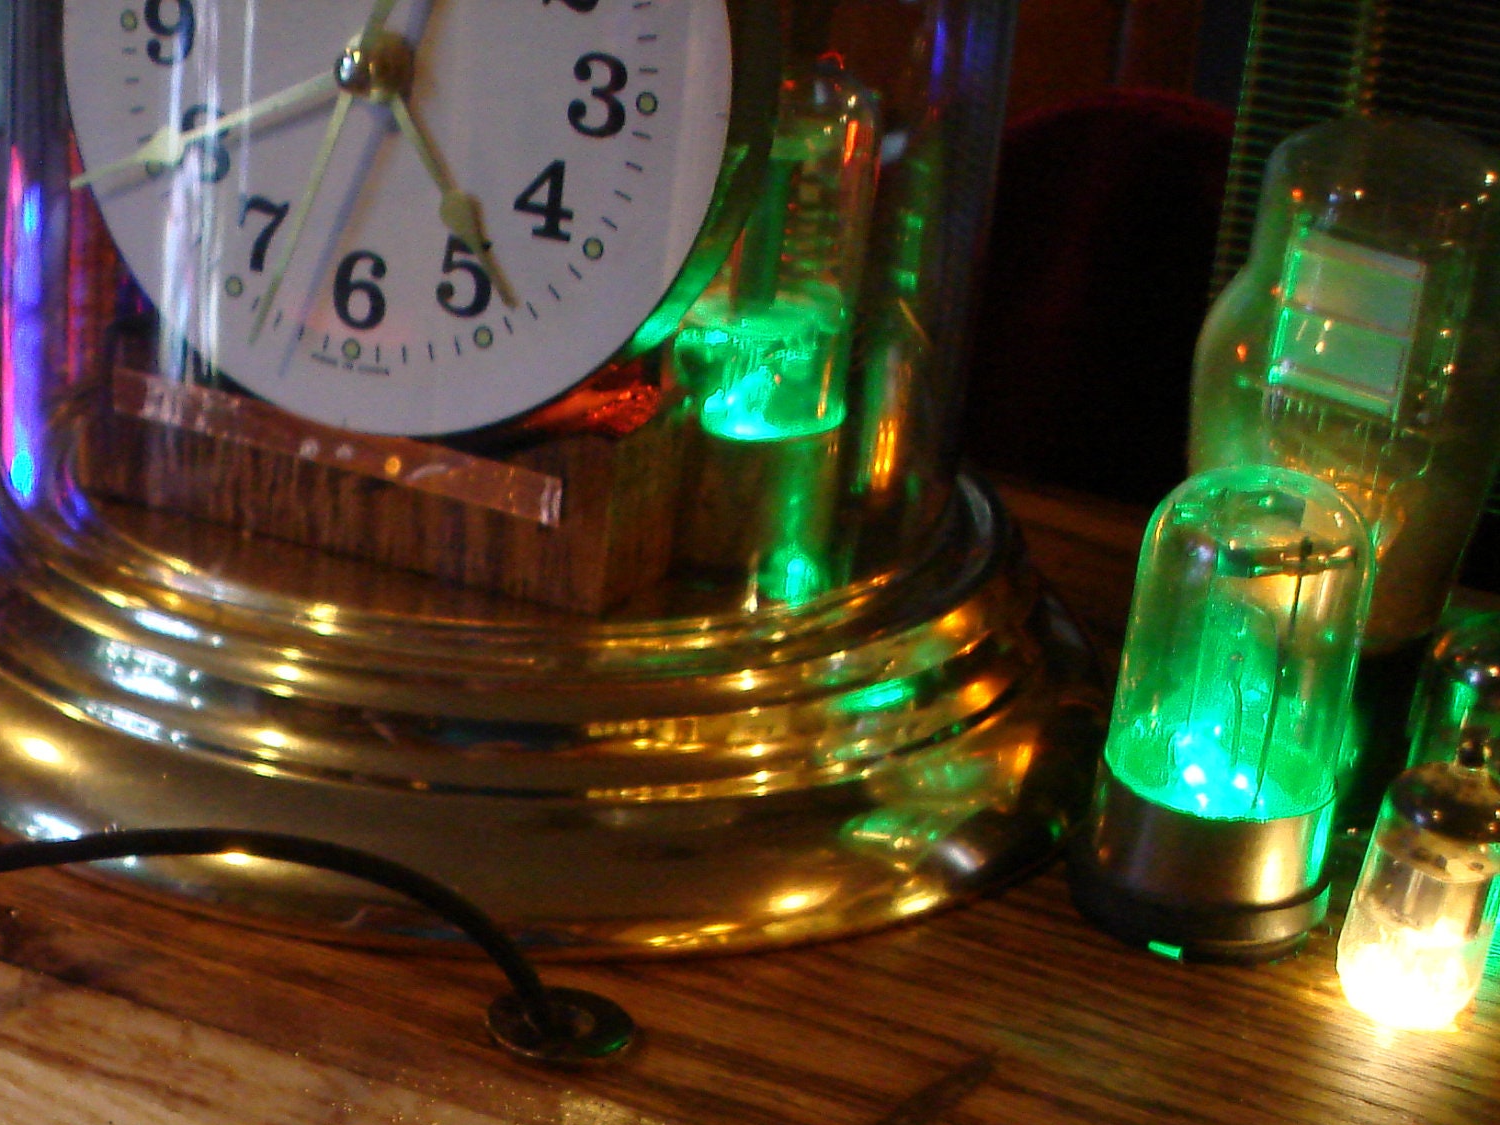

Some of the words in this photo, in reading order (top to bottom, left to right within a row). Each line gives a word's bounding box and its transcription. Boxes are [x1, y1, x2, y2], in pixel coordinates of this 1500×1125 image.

[144, 0, 195, 66] 9
[567, 50, 628, 138] 3
[239, 194, 290, 273] 7
[513, 158, 574, 242] 4
[332, 249, 388, 331] 6
[435, 232, 493, 319] 5
